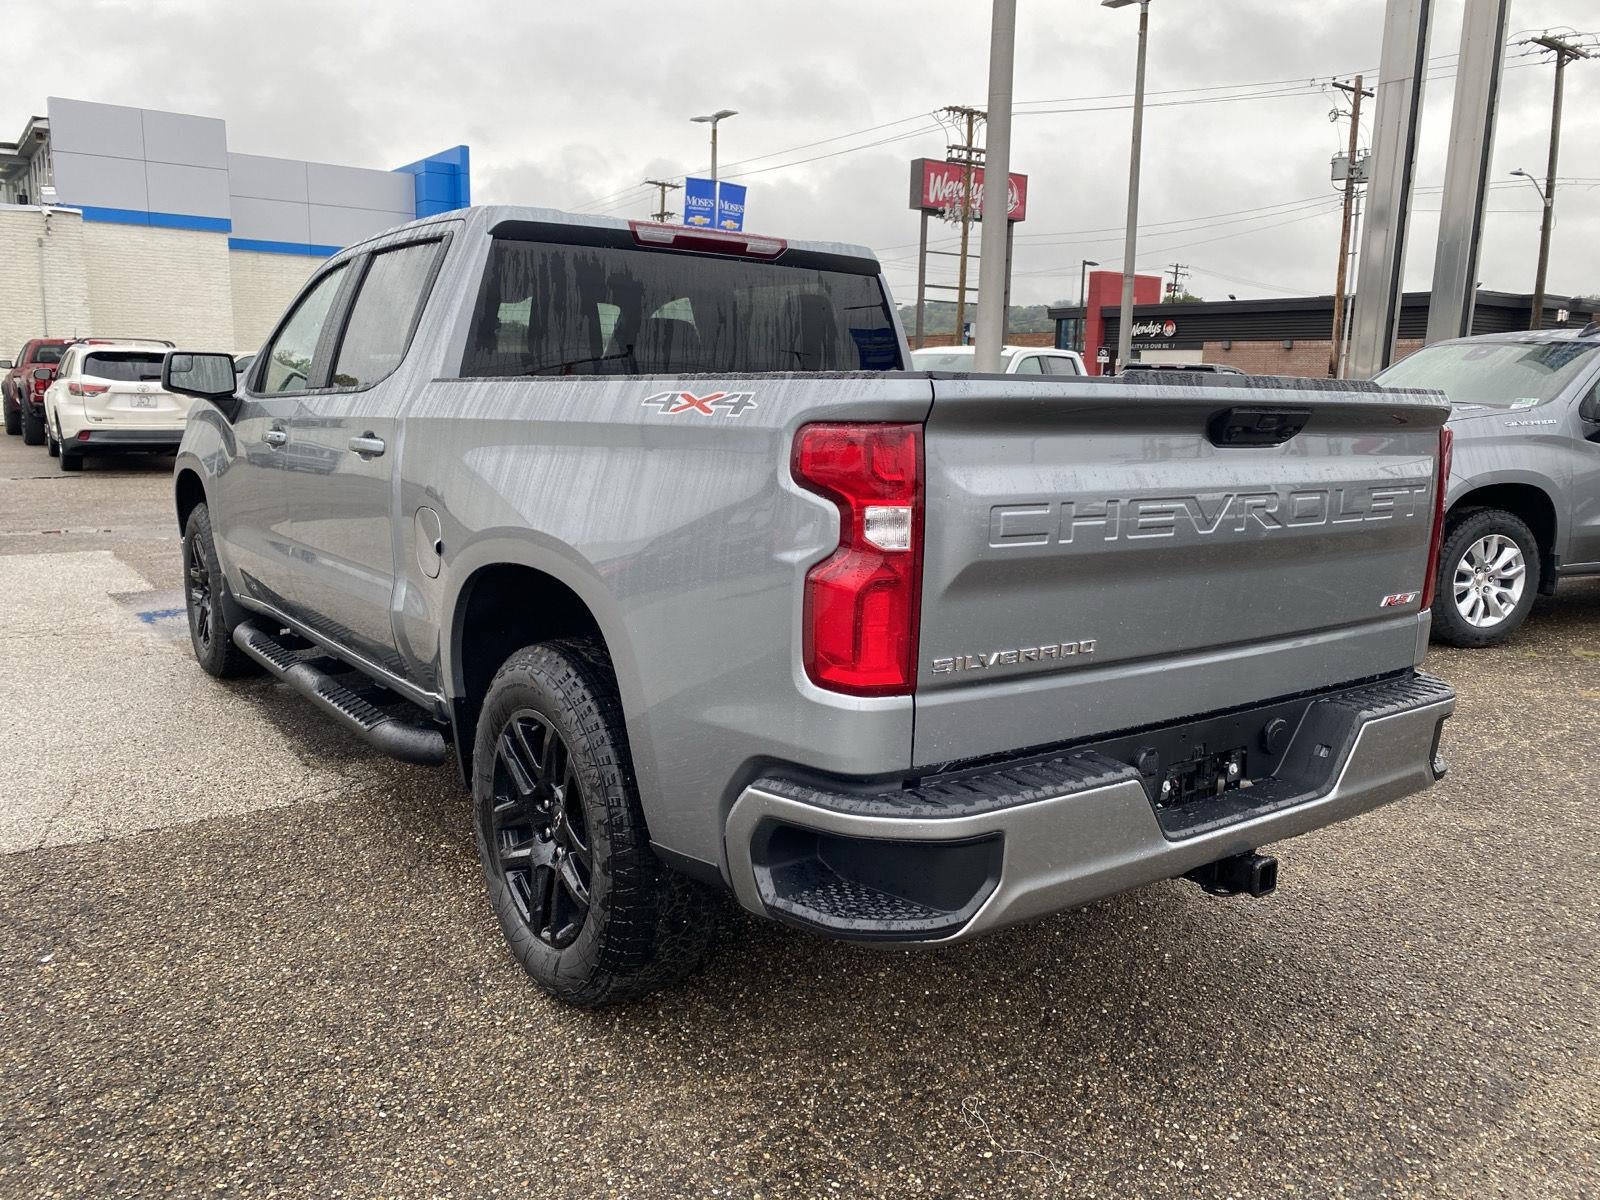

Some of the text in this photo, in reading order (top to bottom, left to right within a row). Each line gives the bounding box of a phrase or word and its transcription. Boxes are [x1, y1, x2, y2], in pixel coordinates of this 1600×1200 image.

[686, 195, 714, 208] MOSES
[988, 484, 1427, 548] CHEVROLET
[932, 639, 1097, 674] SILVERADO
